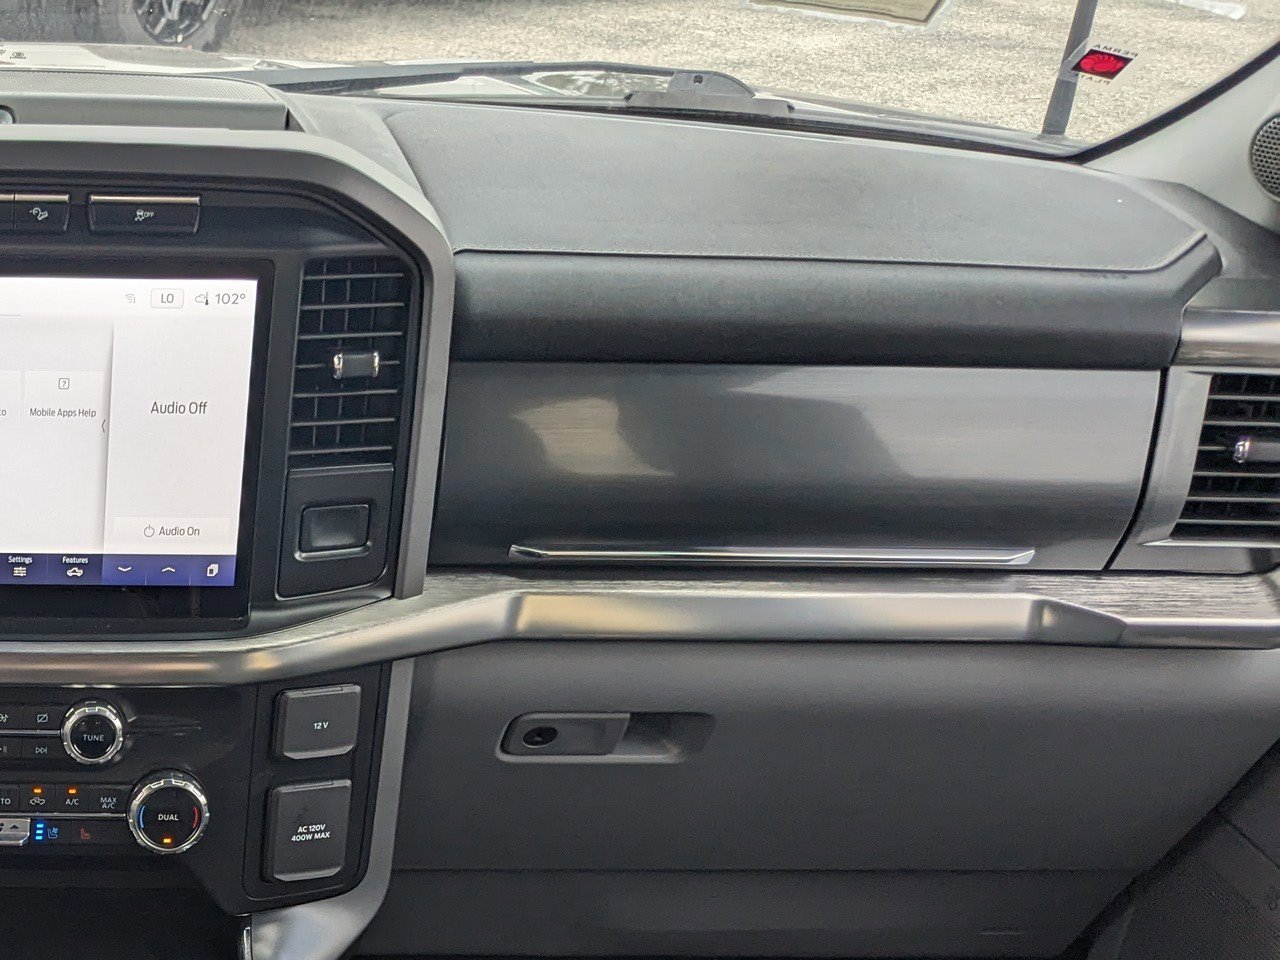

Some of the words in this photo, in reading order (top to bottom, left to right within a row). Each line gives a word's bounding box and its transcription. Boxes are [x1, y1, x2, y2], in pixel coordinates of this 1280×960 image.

[161, 293, 175, 304] LO
[215, 293, 246, 305] 102°
[150, 401, 186, 415] Audio
[188, 401, 208, 415] Off
[29, 408, 56, 417] Mobile
[57, 408, 77, 418] Apps
[78, 408, 97, 418] Help
[158, 526, 184, 537] Audio
[186, 527, 200, 537] On
[8, 556, 33, 564] Settings
[62, 556, 89, 564] Features
[313, 722, 322, 730] 12
[82, 734, 104, 742] TUNE
[65, 798, 79, 806] A/C
[157, 813, 179, 821] DUAL
[297, 825, 308, 833] AC
[309, 824, 326, 832] 120V
[291, 833, 313, 842] 400W
[313, 832, 331, 840] MAX
